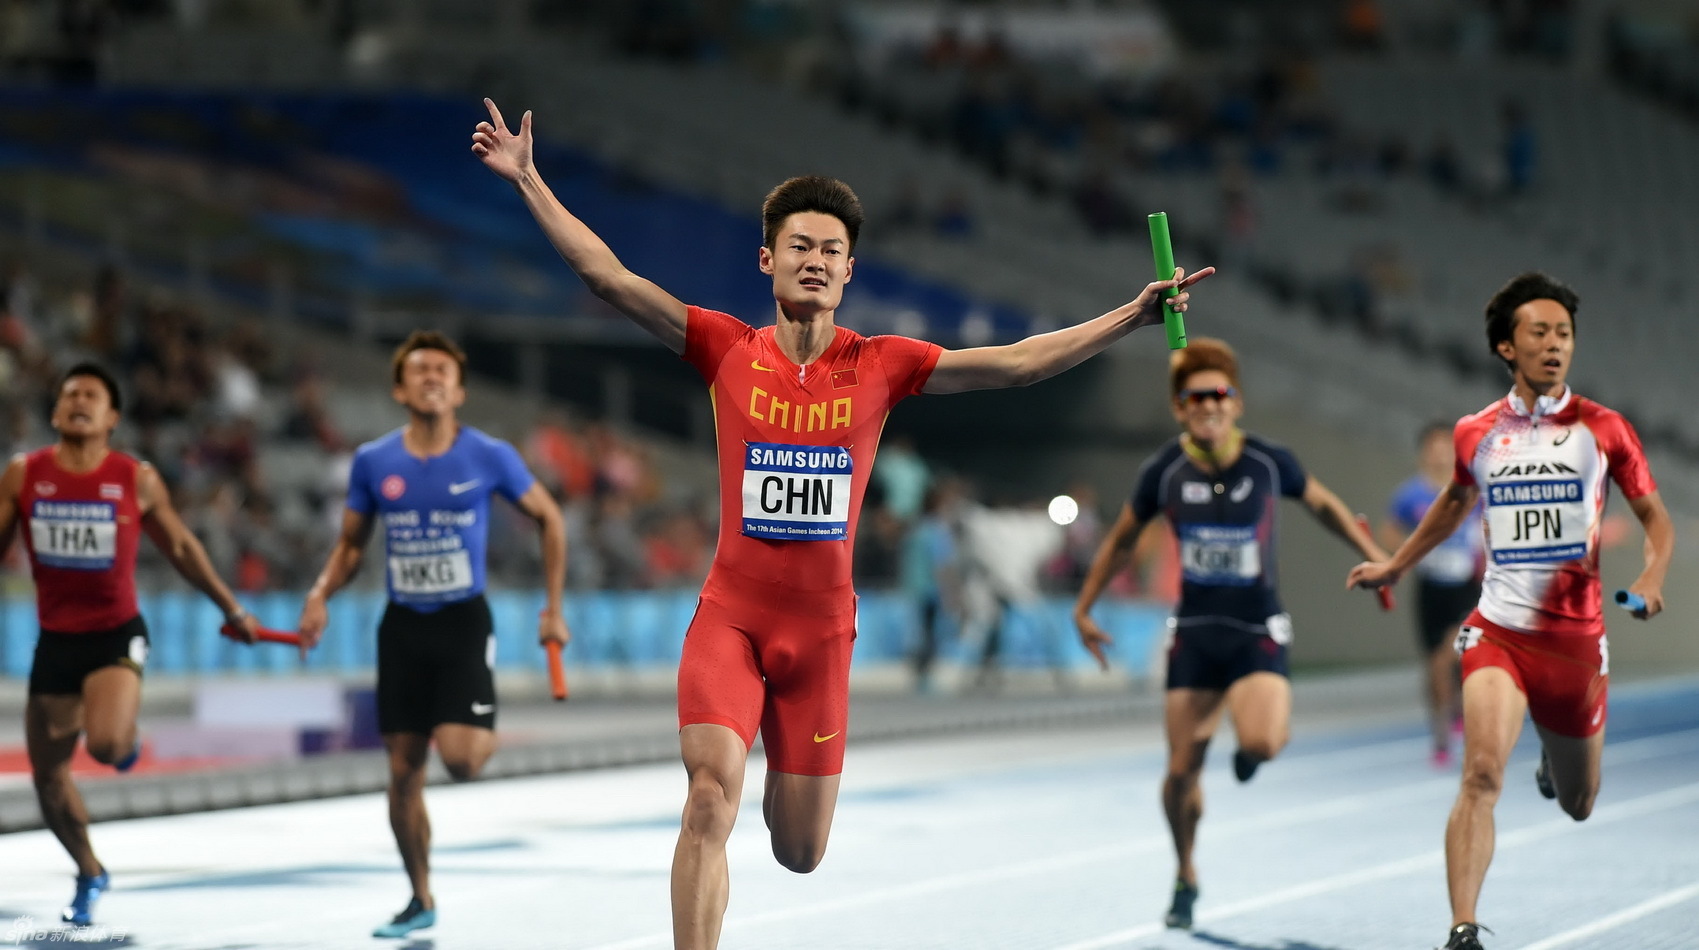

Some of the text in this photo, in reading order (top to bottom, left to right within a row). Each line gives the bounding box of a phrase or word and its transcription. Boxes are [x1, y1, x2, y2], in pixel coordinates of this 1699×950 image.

[749, 386, 852, 433] CHINA
[750, 448, 848, 469] SAMSUNG
[1490, 462, 1579, 478] JAPAN
[760, 475, 833, 515] CHN
[1491, 483, 1578, 503] SAMSUNG
[48, 523, 98, 551] THA
[746, 523, 843, 536] The 17th Asian Games Incheon 2014
[1512, 509, 1562, 541] JPN
[403, 558, 456, 585] HKG
